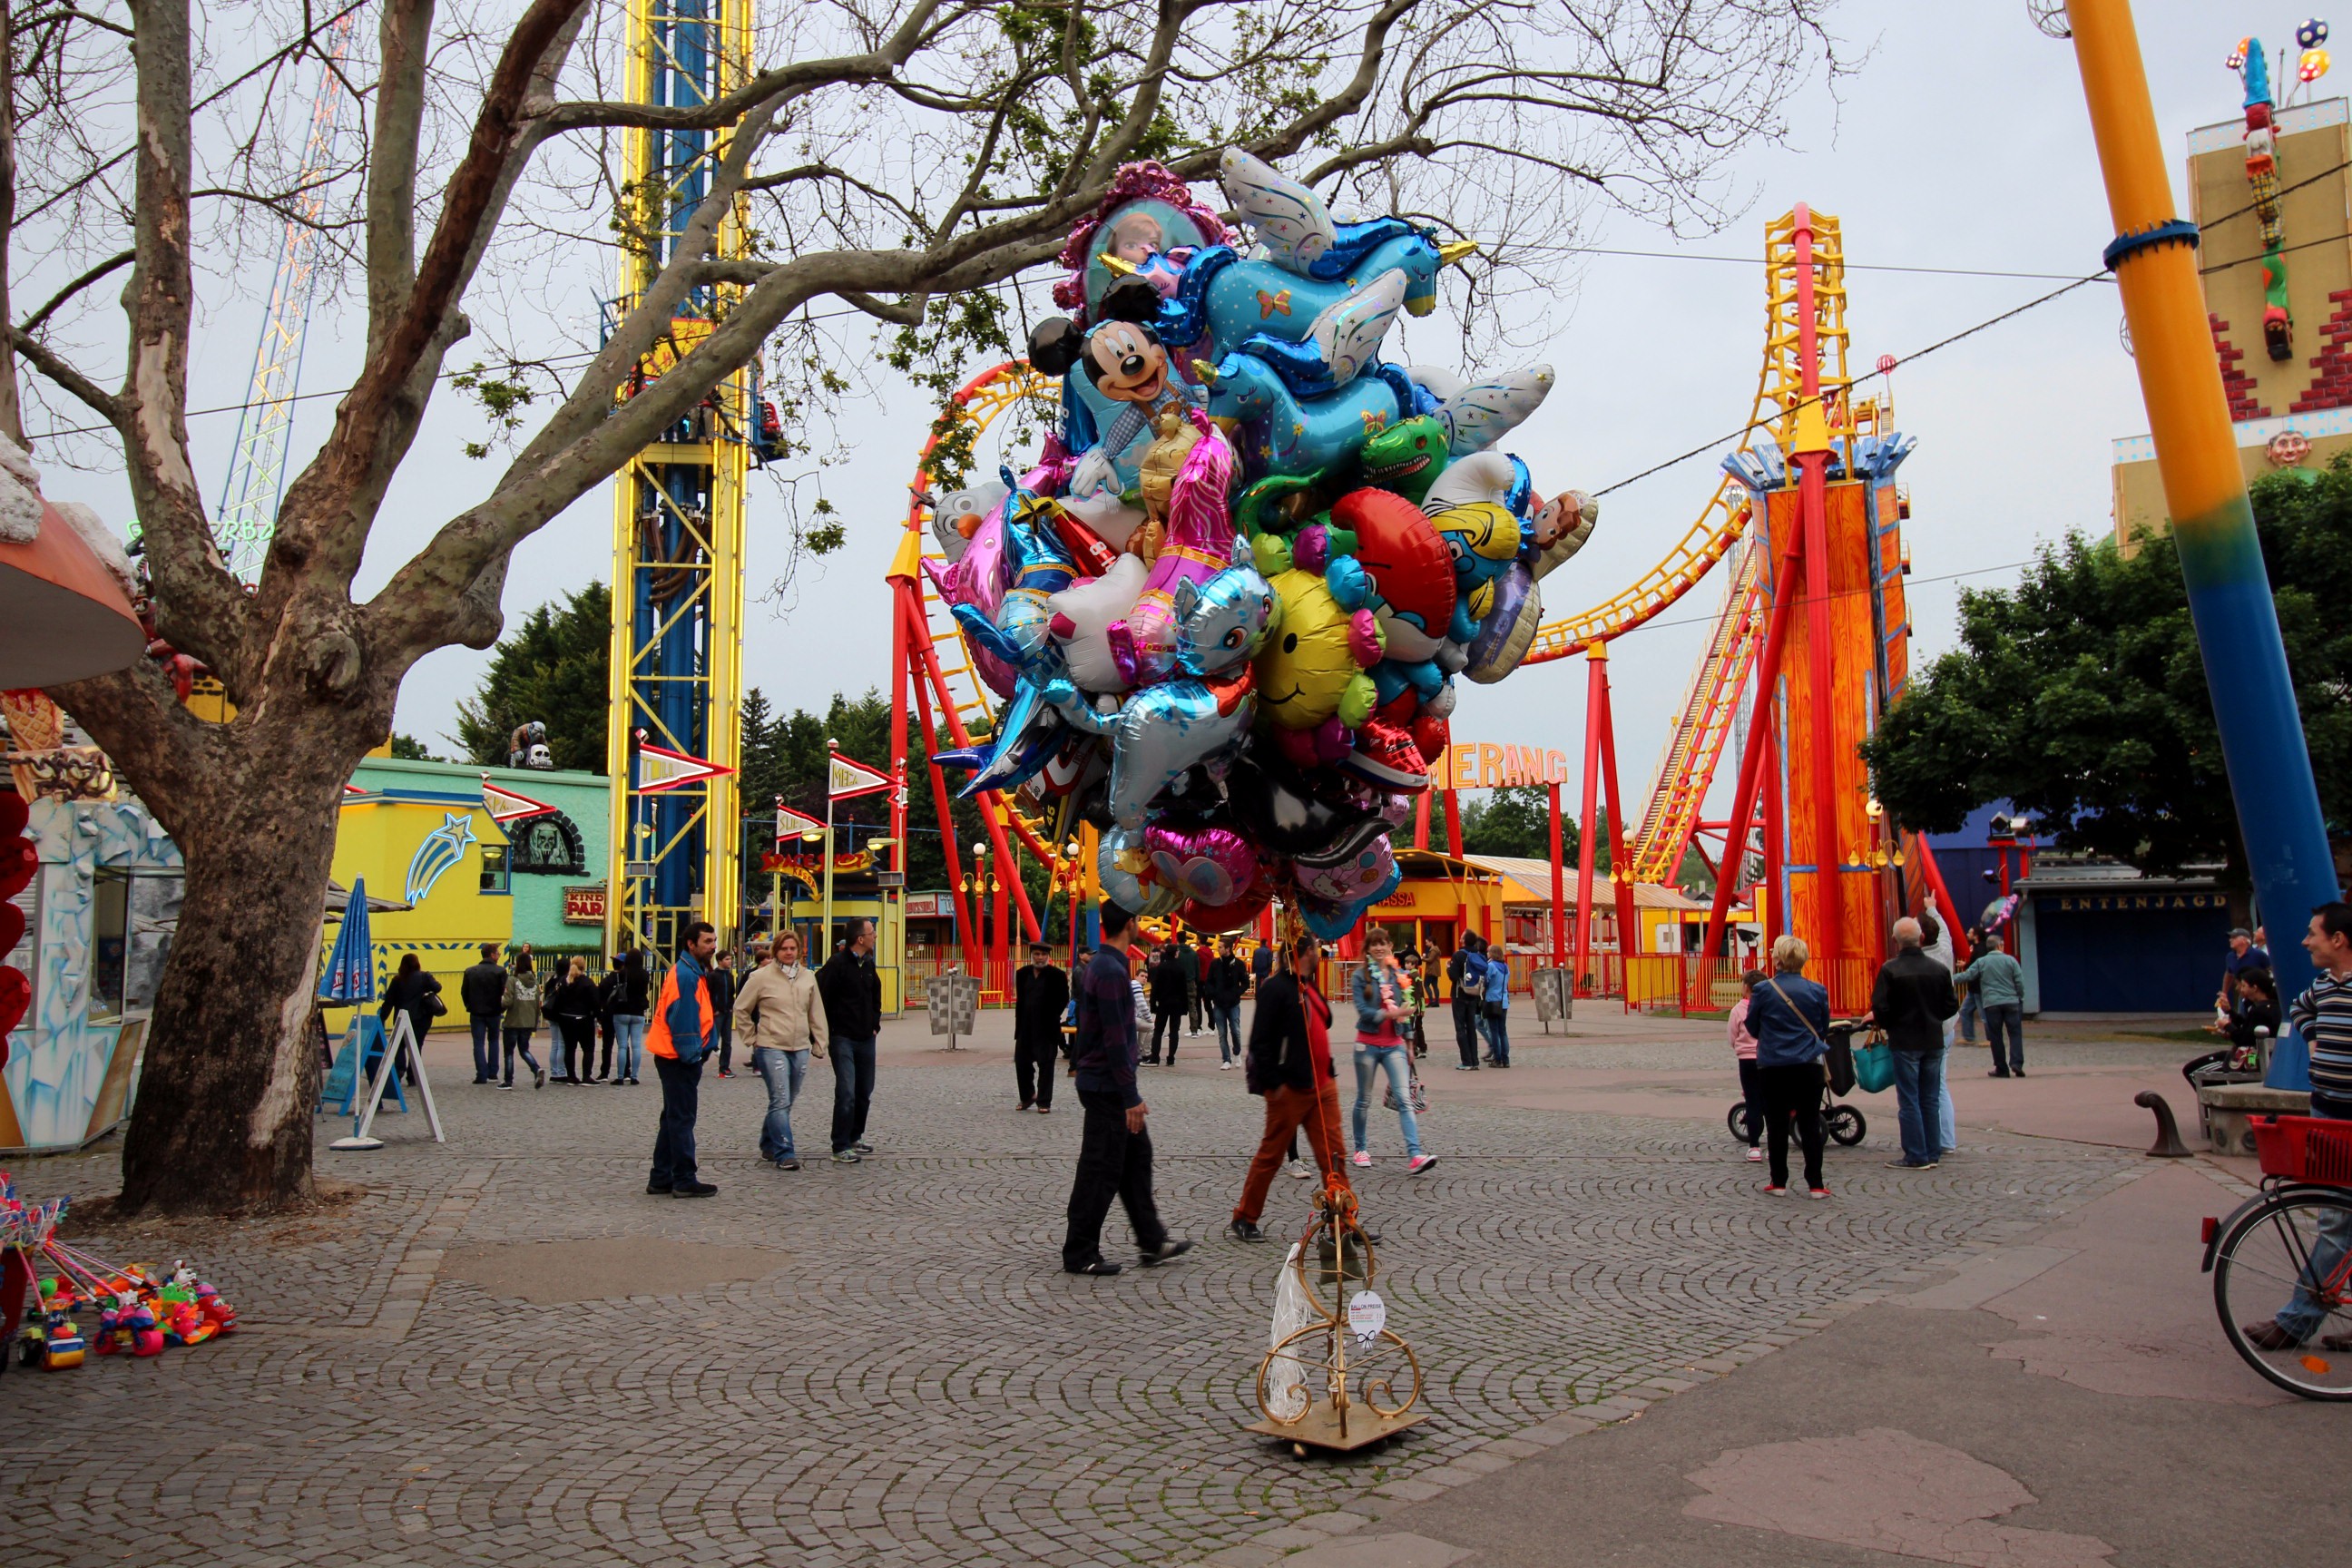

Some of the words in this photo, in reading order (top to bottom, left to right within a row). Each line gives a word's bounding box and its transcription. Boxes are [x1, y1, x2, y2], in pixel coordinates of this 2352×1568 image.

[759, 849, 815, 873] SPACE
[792, 867, 816, 888] KASSA
[2061, 895, 2226, 910] ENTENJAGD
